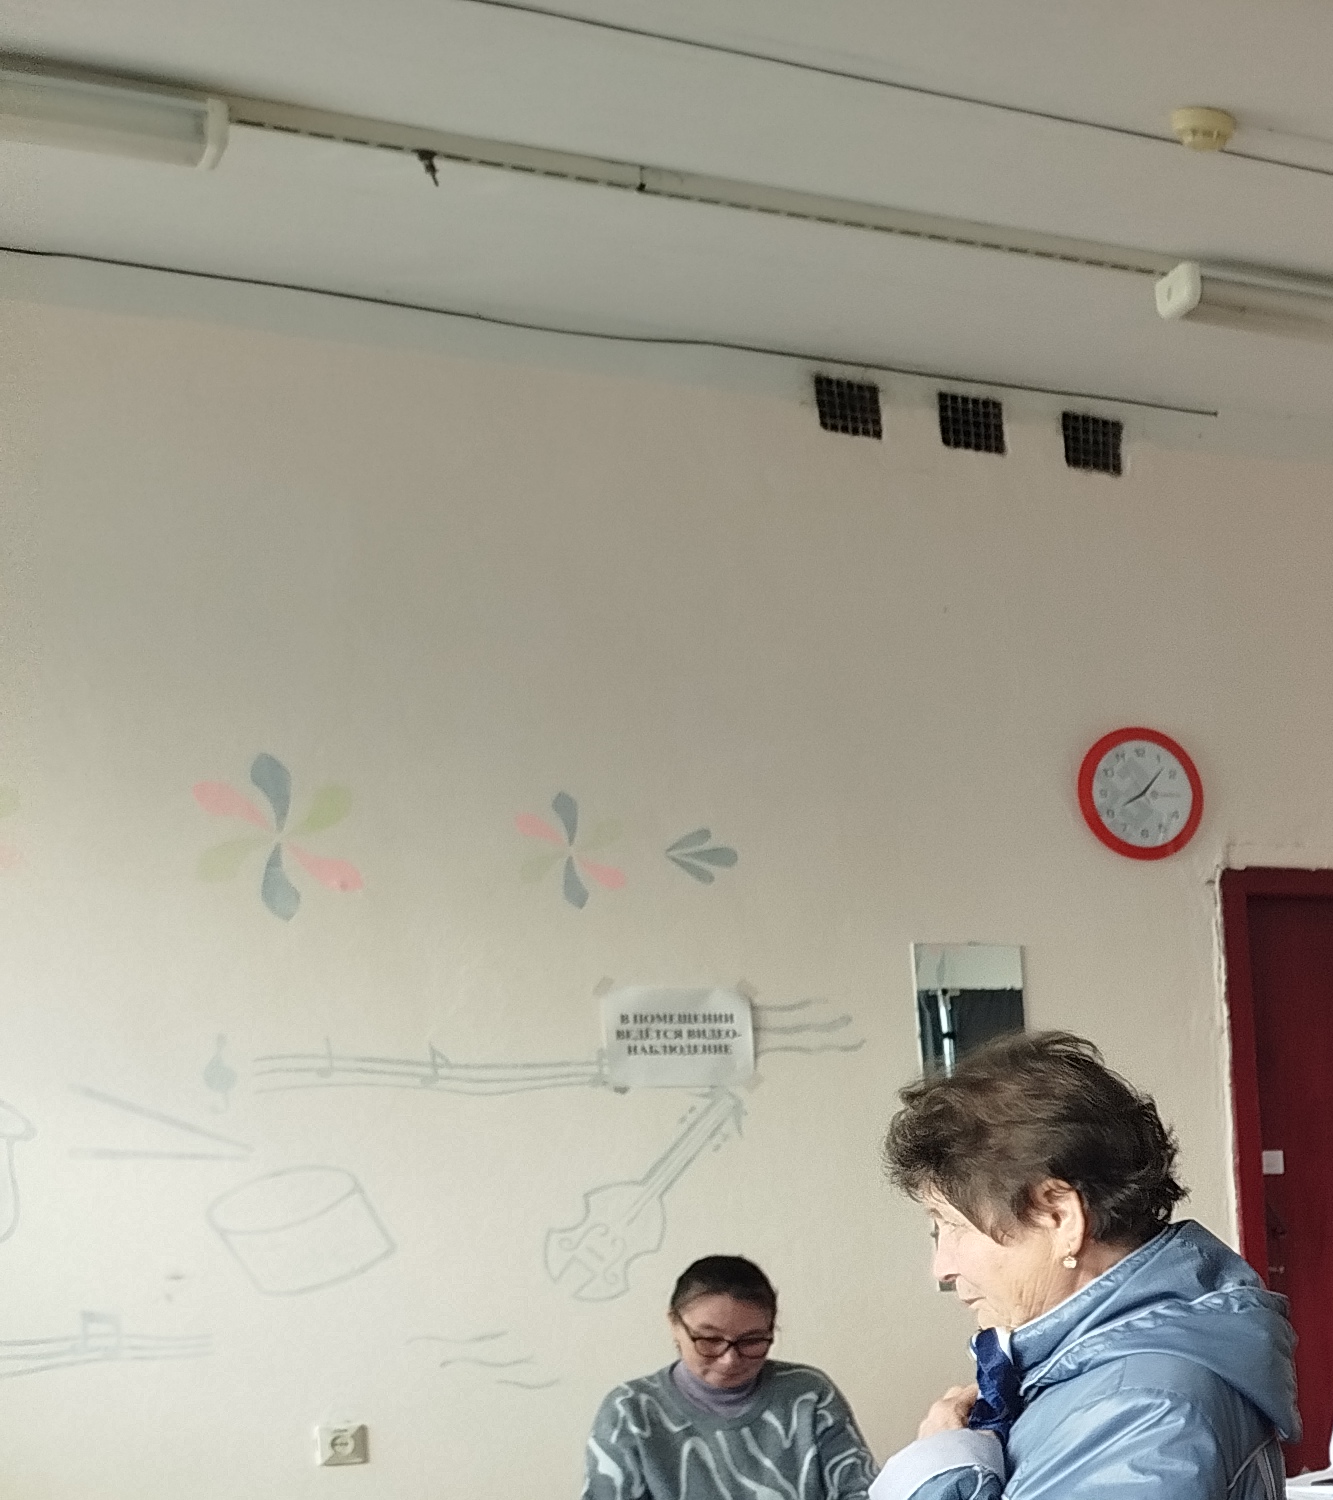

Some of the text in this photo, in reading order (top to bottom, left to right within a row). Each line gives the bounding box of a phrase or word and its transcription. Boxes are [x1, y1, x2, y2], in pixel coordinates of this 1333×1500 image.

[620, 1013, 734, 1025] В ПОМЕЩЕНИИ
[616, 1027, 742, 1041] ВЕДЁТСЯ ВИДЕО-
[627, 1044, 732, 1056] НАБЛЮДЕНИЕ
